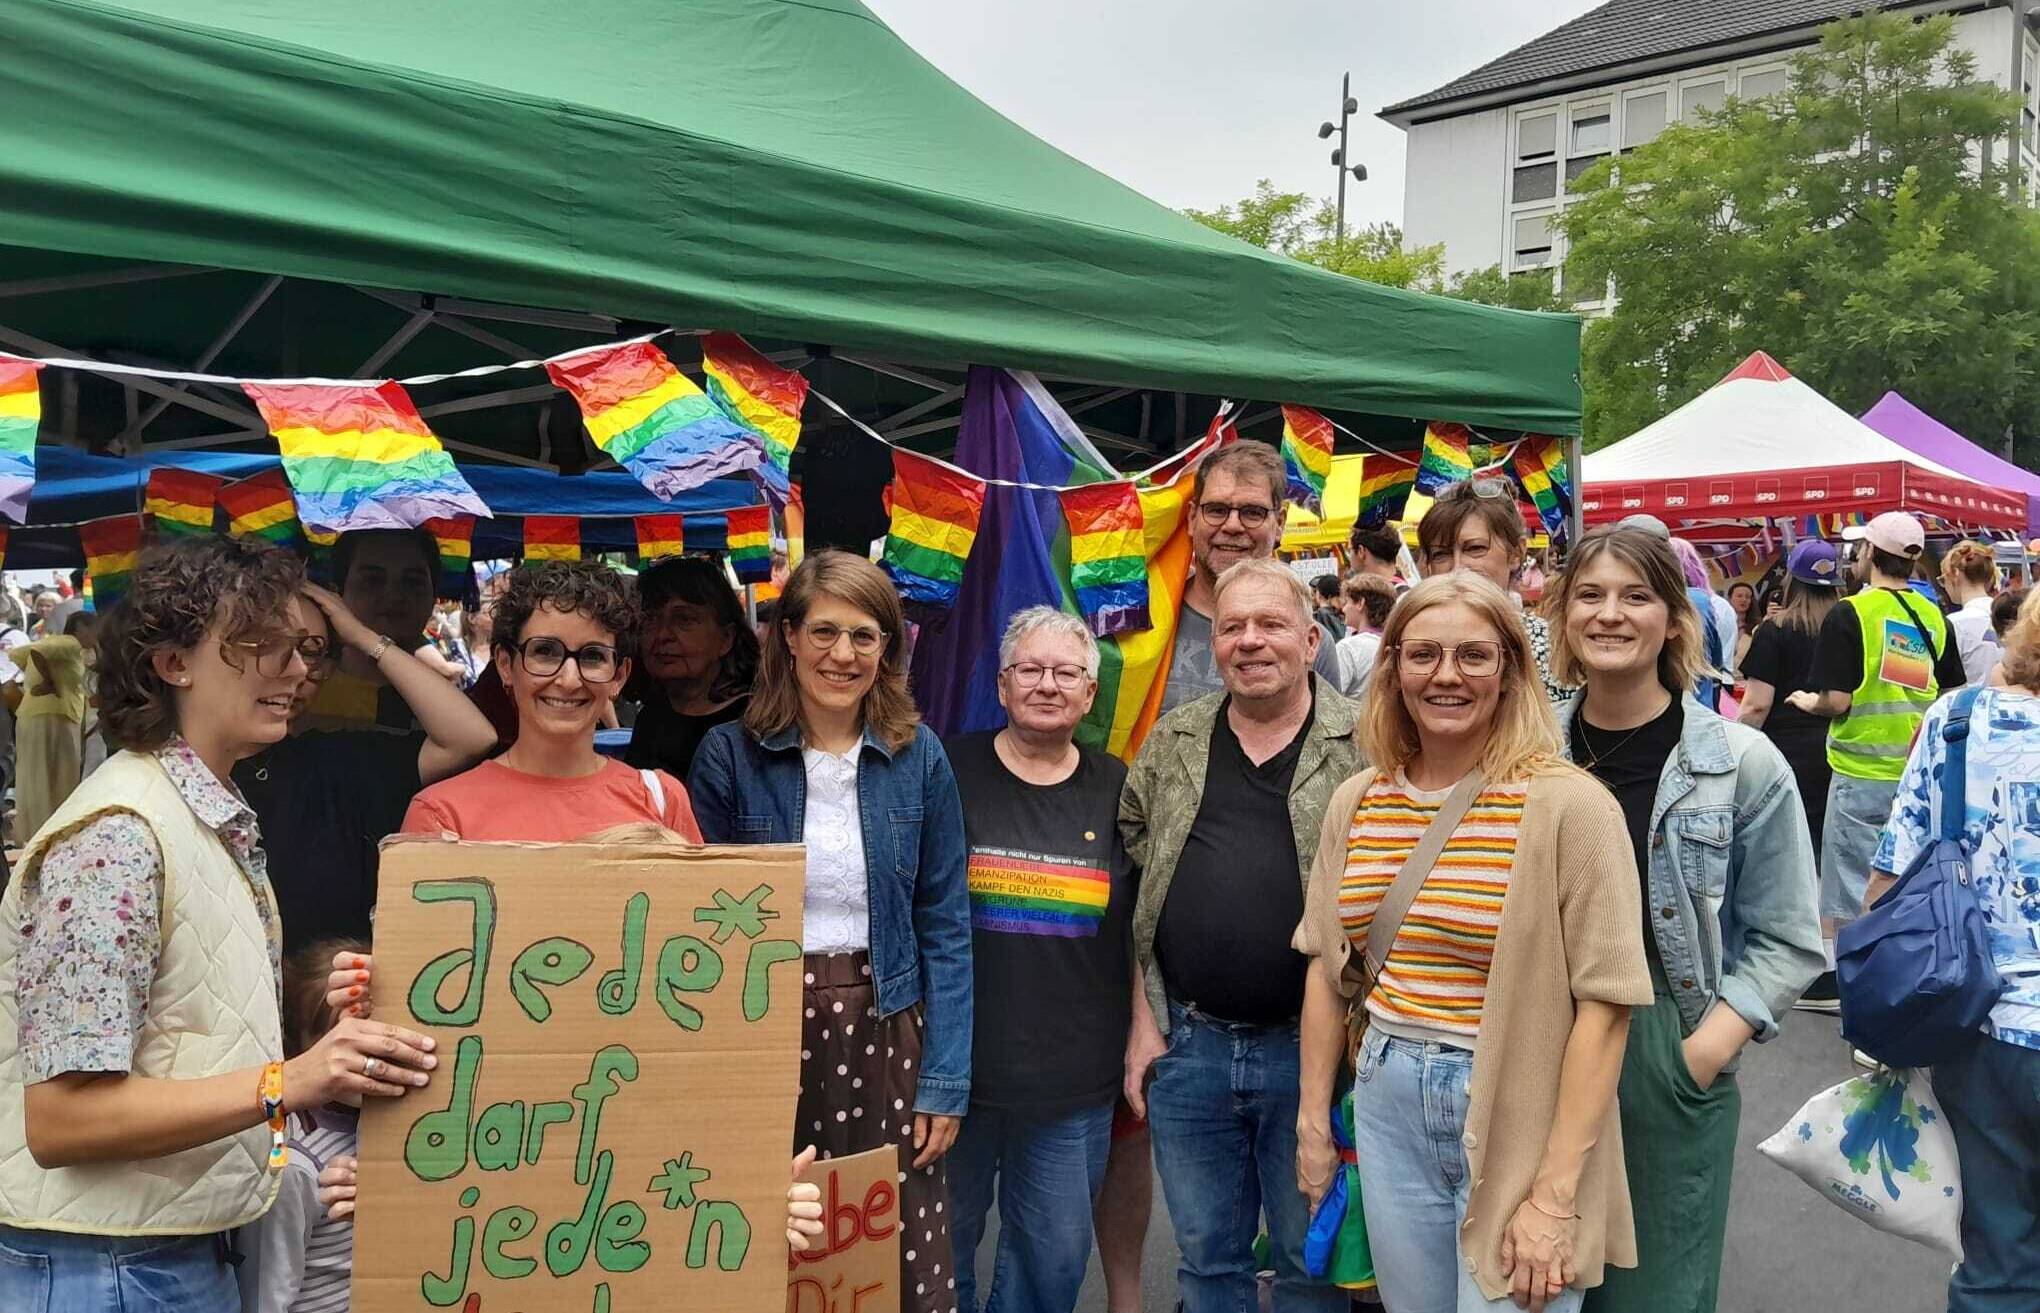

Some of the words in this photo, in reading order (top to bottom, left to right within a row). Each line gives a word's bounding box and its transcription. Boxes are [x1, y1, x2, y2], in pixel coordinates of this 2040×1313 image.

[1805, 489, 1825, 499] SPD
[1855, 486, 1875, 496] SPD
[1666, 496, 1684, 505] SPD
[1711, 494, 1729, 504] SPD
[1757, 492, 1776, 501] SPD
[1624, 499, 1641, 508] SPD
[1008, 850, 1027, 859] nicht
[1043, 854, 1071, 864] Spuren
[1073, 859, 1087, 867] von
[969, 867, 1047, 885] EMANZIPATION
[969, 880, 1007, 892] KAMPF
[1009, 884, 1031, 894] DEN
[1034, 885, 1065, 899] NAZIS
[404, 1035, 639, 1185] darf
